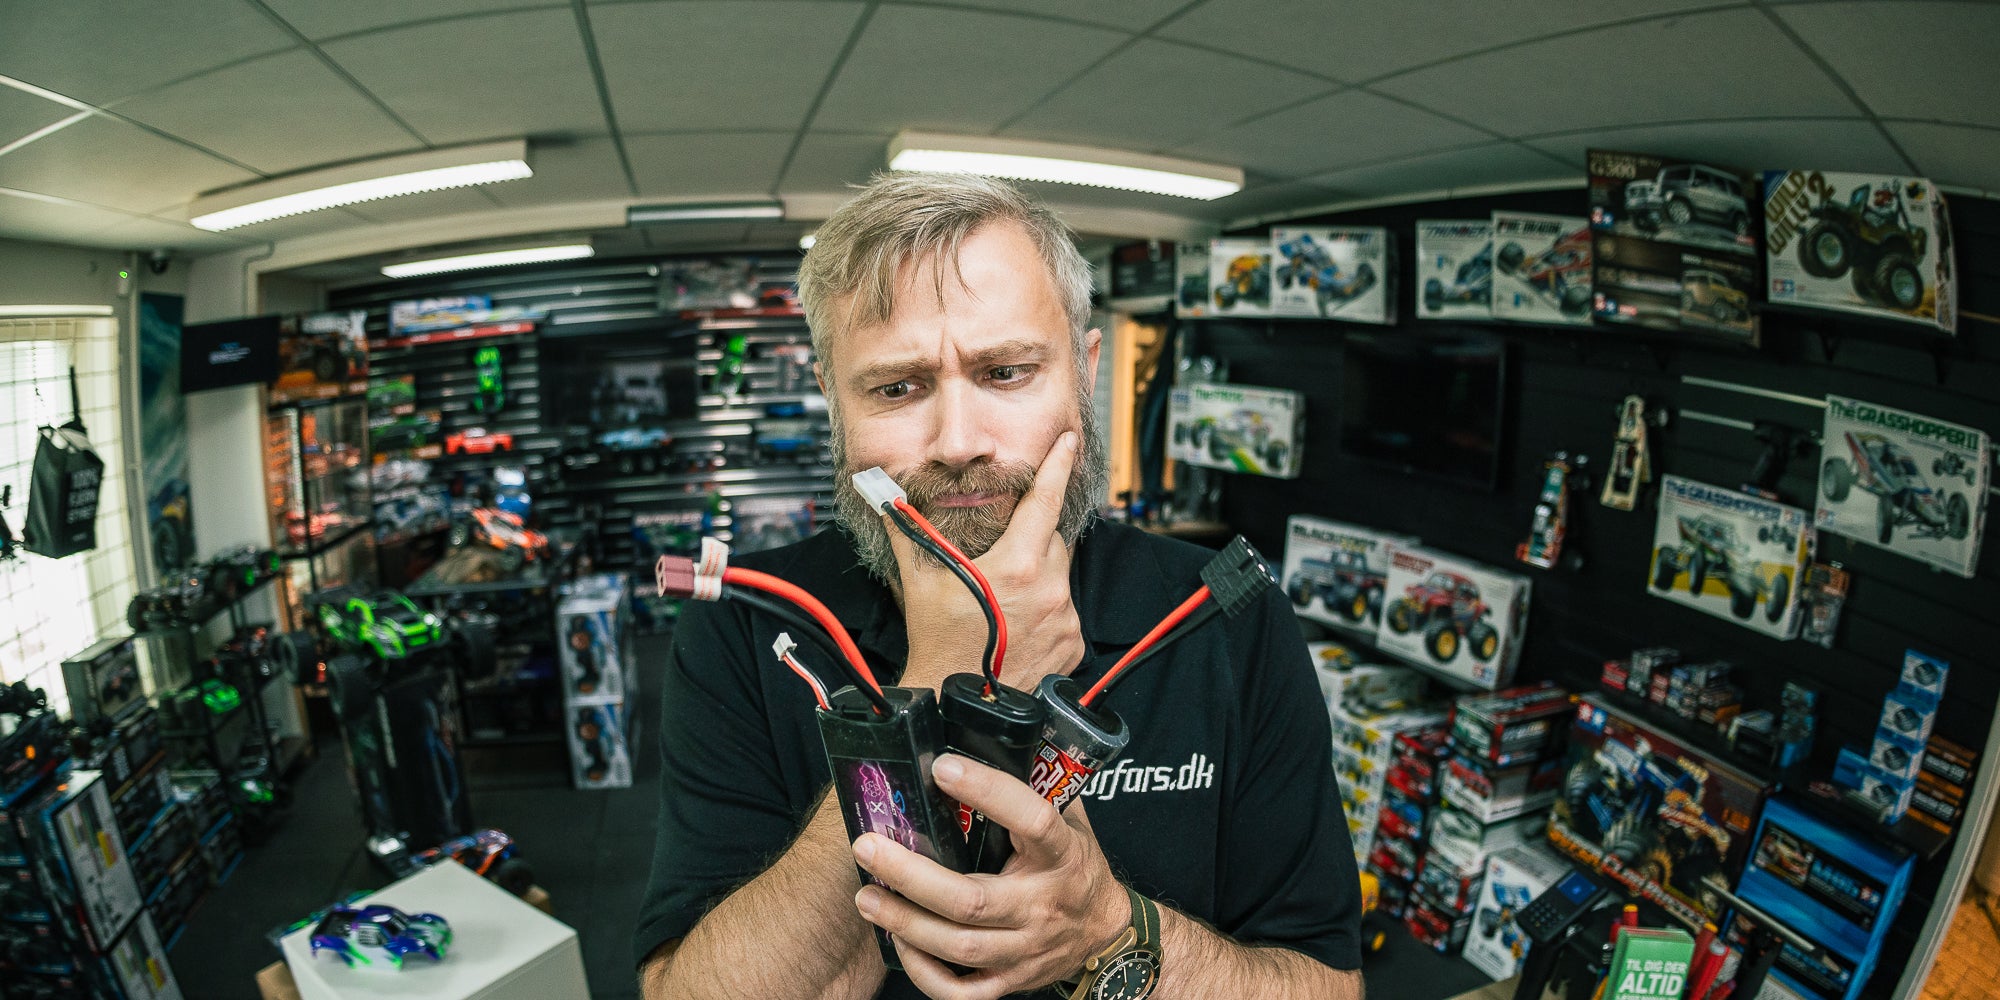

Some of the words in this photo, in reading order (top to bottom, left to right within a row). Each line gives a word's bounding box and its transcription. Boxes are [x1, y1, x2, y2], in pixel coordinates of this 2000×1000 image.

[1766, 170, 1806, 223] WILD
[1807, 171, 1835, 204] 2
[1768, 193, 1812, 255] WILLY
[1830, 400, 1857, 419] The
[1857, 406, 1965, 446] GRASSHOPPER
[1618, 972, 1683, 996] ALTID
[1626, 958, 1642, 972] TIL
[1644, 959, 1663, 972] DIG
